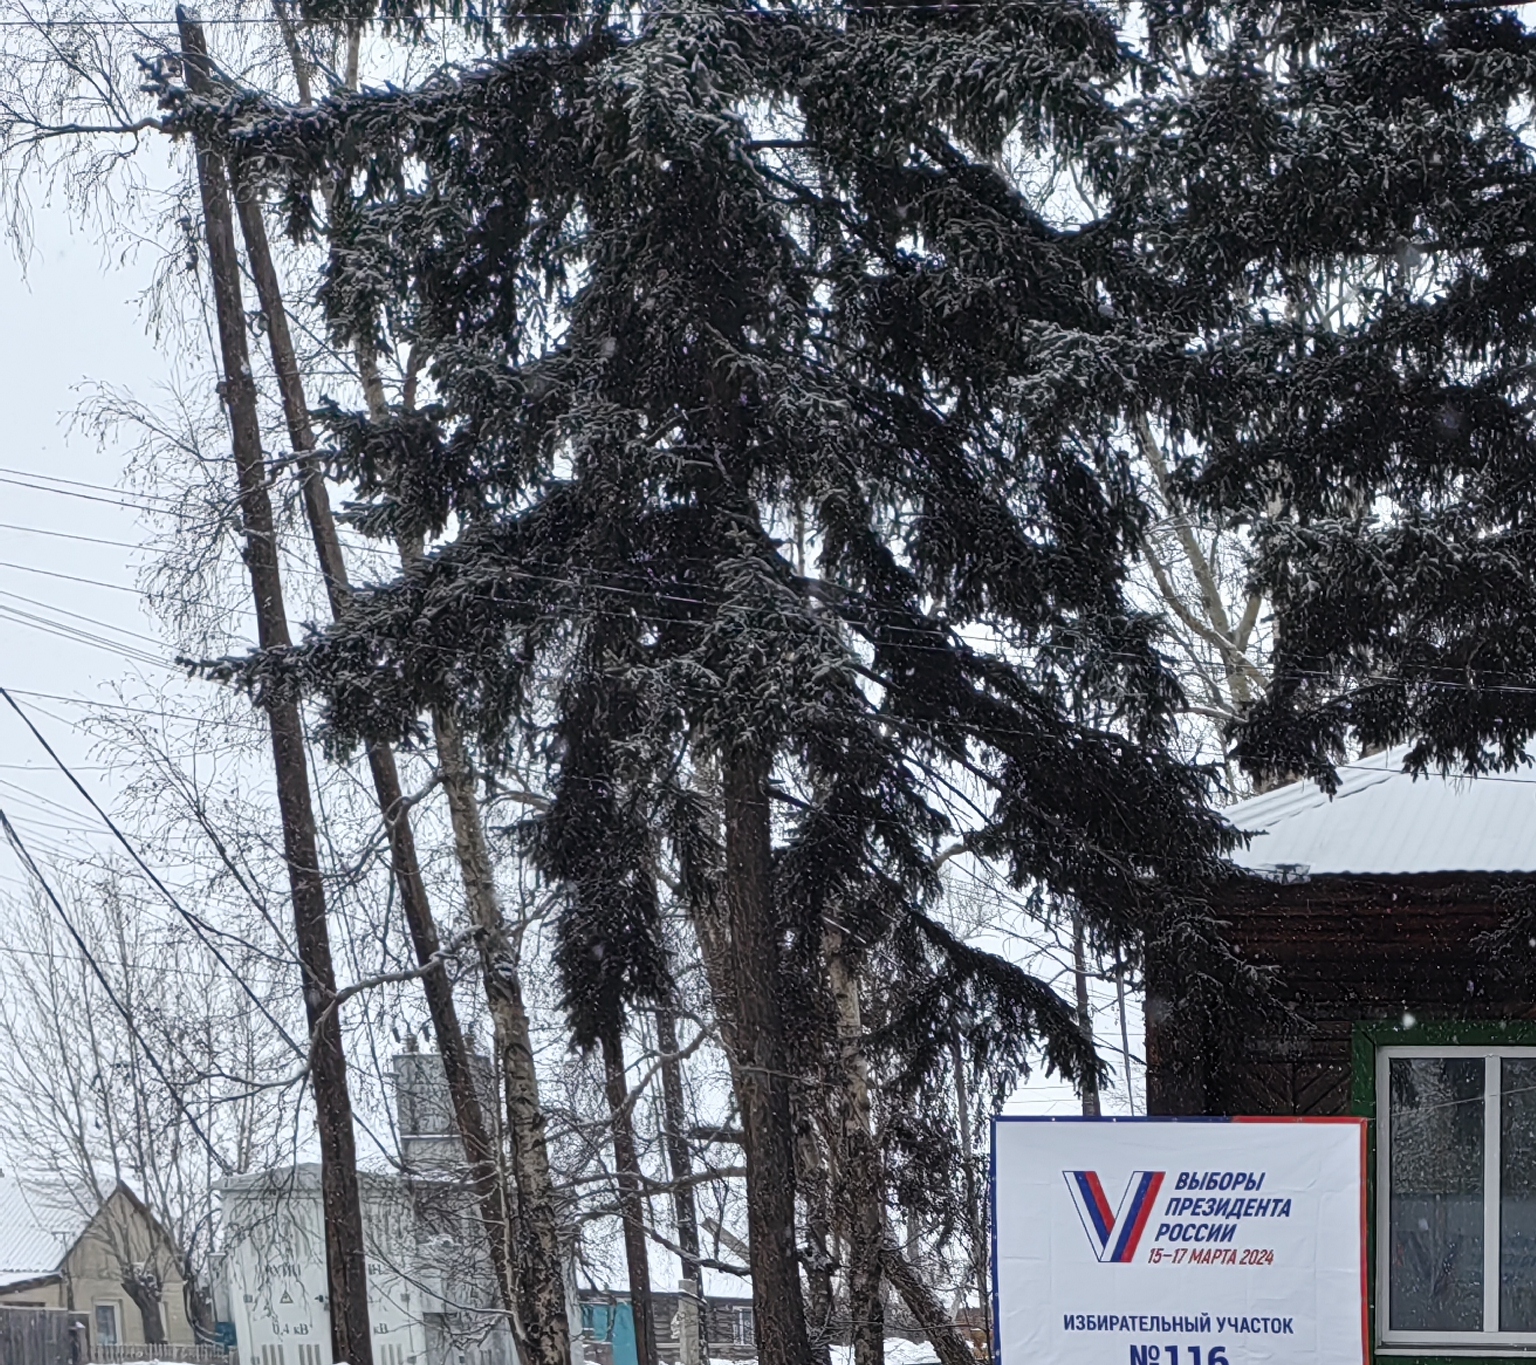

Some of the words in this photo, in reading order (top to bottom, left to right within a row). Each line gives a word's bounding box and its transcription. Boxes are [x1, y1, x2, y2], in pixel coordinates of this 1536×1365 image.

[1175, 1171, 1266, 1191] ВЫБОРЫ
[1164, 1198, 1292, 1219] ПРЕЗИДЕНТА
[1154, 1223, 1237, 1242] РОССИИ
[1188, 1248, 1237, 1265] МАРТА
[1239, 1248, 1274, 1266] 2024
[1063, 1313, 1211, 1333] ИЗБИРАТЕЛЬНЫЙ
[1216, 1317, 1294, 1334] УЧАСТОК
